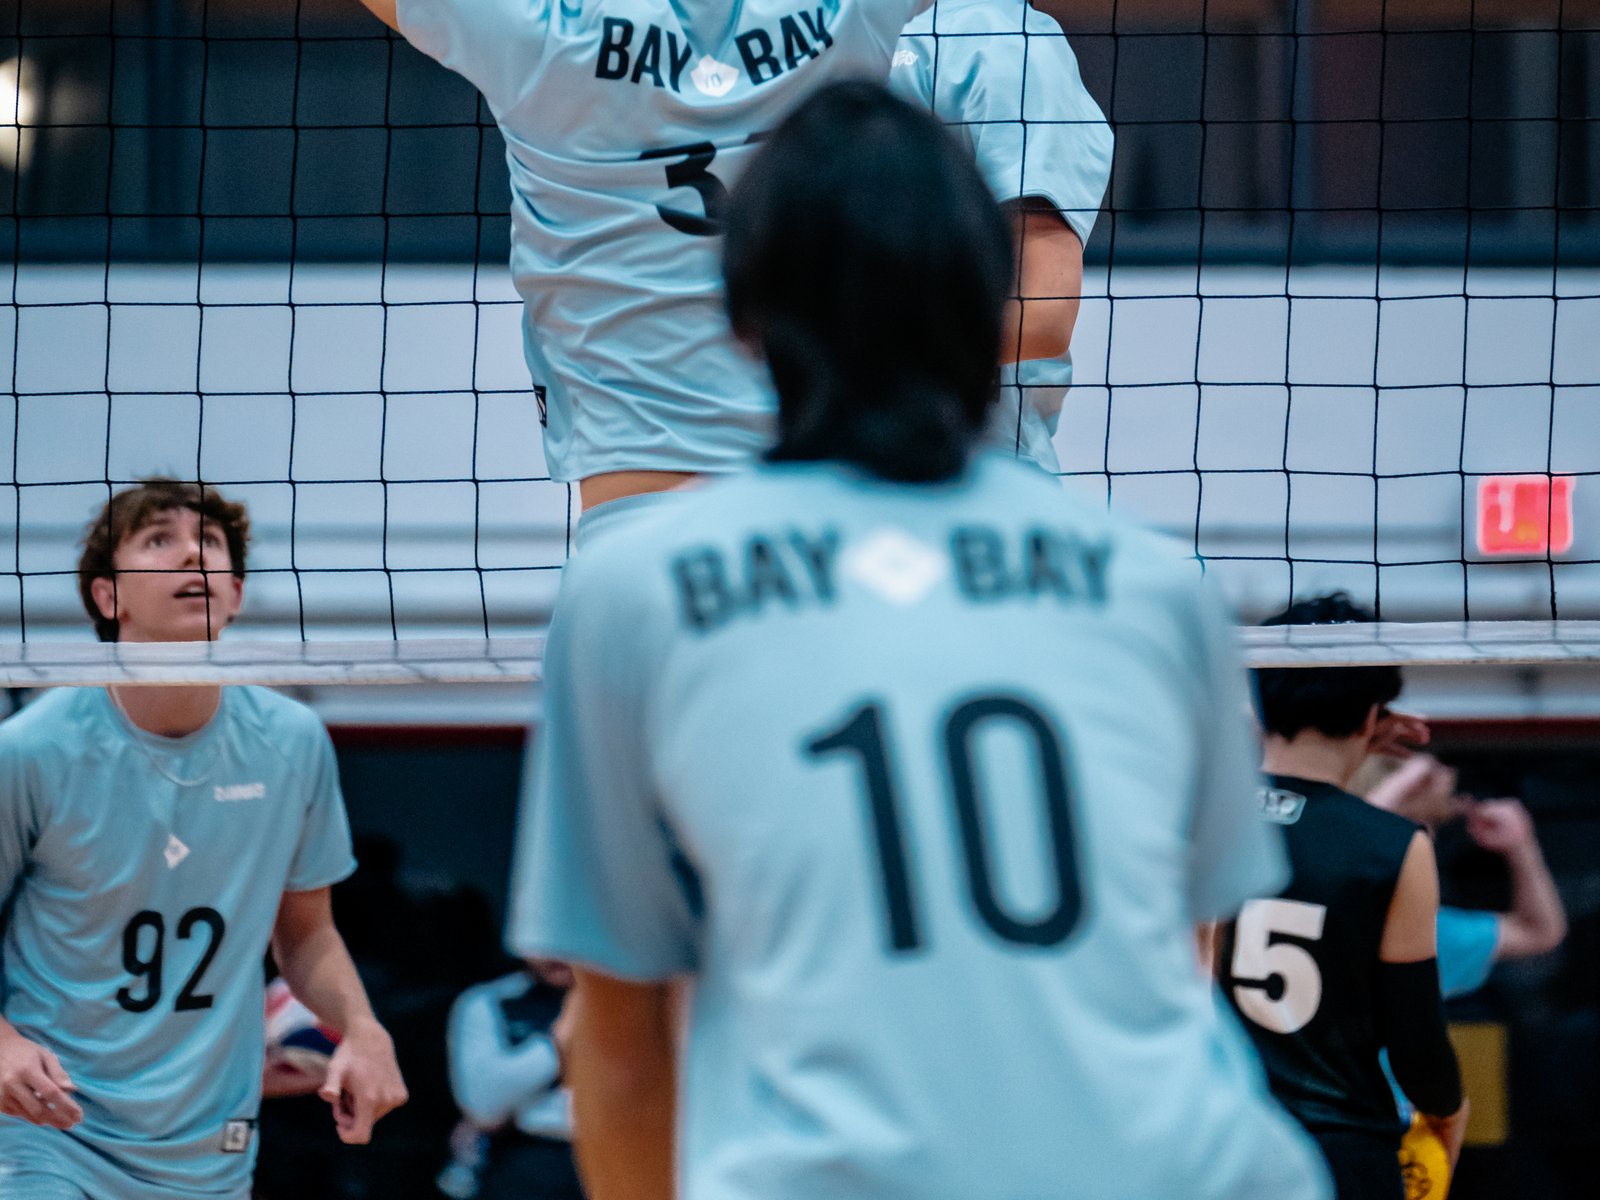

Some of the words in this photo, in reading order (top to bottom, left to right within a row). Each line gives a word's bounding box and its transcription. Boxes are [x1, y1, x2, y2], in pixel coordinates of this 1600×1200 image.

[595, 16, 692, 93] BAY
[735, 7, 833, 86] BAY
[671, 528, 841, 633] BAY
[951, 526, 1111, 609] BAY
[801, 689, 1091, 954] 10
[116, 907, 226, 1014] 92
[1231, 899, 1326, 1035] 5
